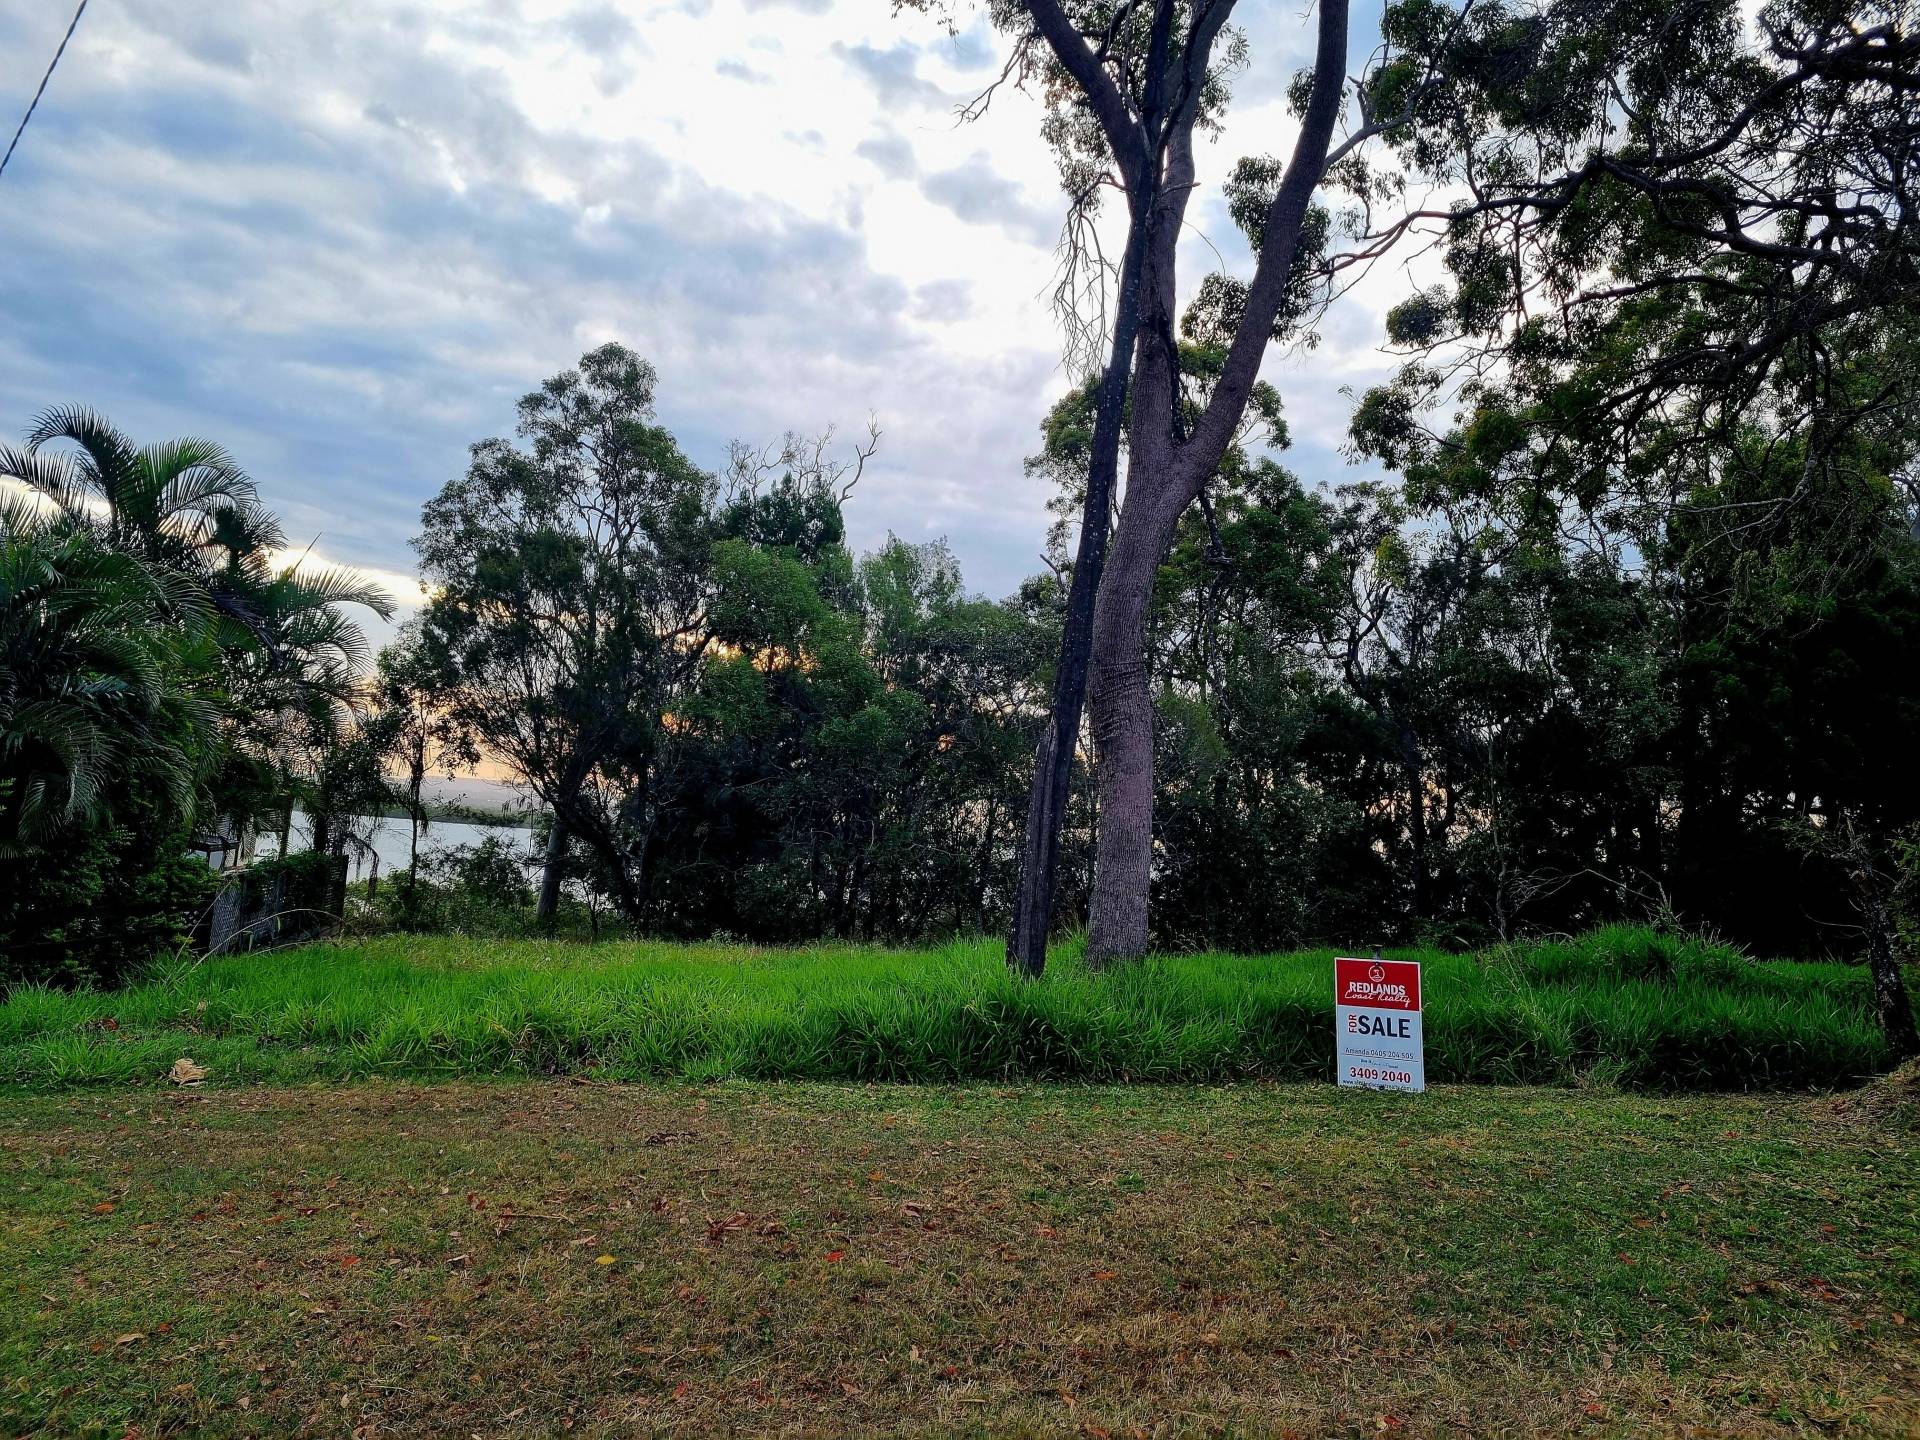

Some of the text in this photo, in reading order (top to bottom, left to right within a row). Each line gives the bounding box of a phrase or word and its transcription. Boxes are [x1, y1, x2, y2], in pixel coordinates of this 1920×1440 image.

[1349, 981, 1406, 996] REDLANDS
[1345, 989, 1411, 1008] Coast Realty
[1348, 1014, 1357, 1033] FOR
[1358, 1015, 1411, 1038] SALE
[1345, 1047, 1369, 1056] Amanda
[1370, 1049, 1386, 1058] 0405
[1350, 1066, 1411, 1083] 3409 2040
